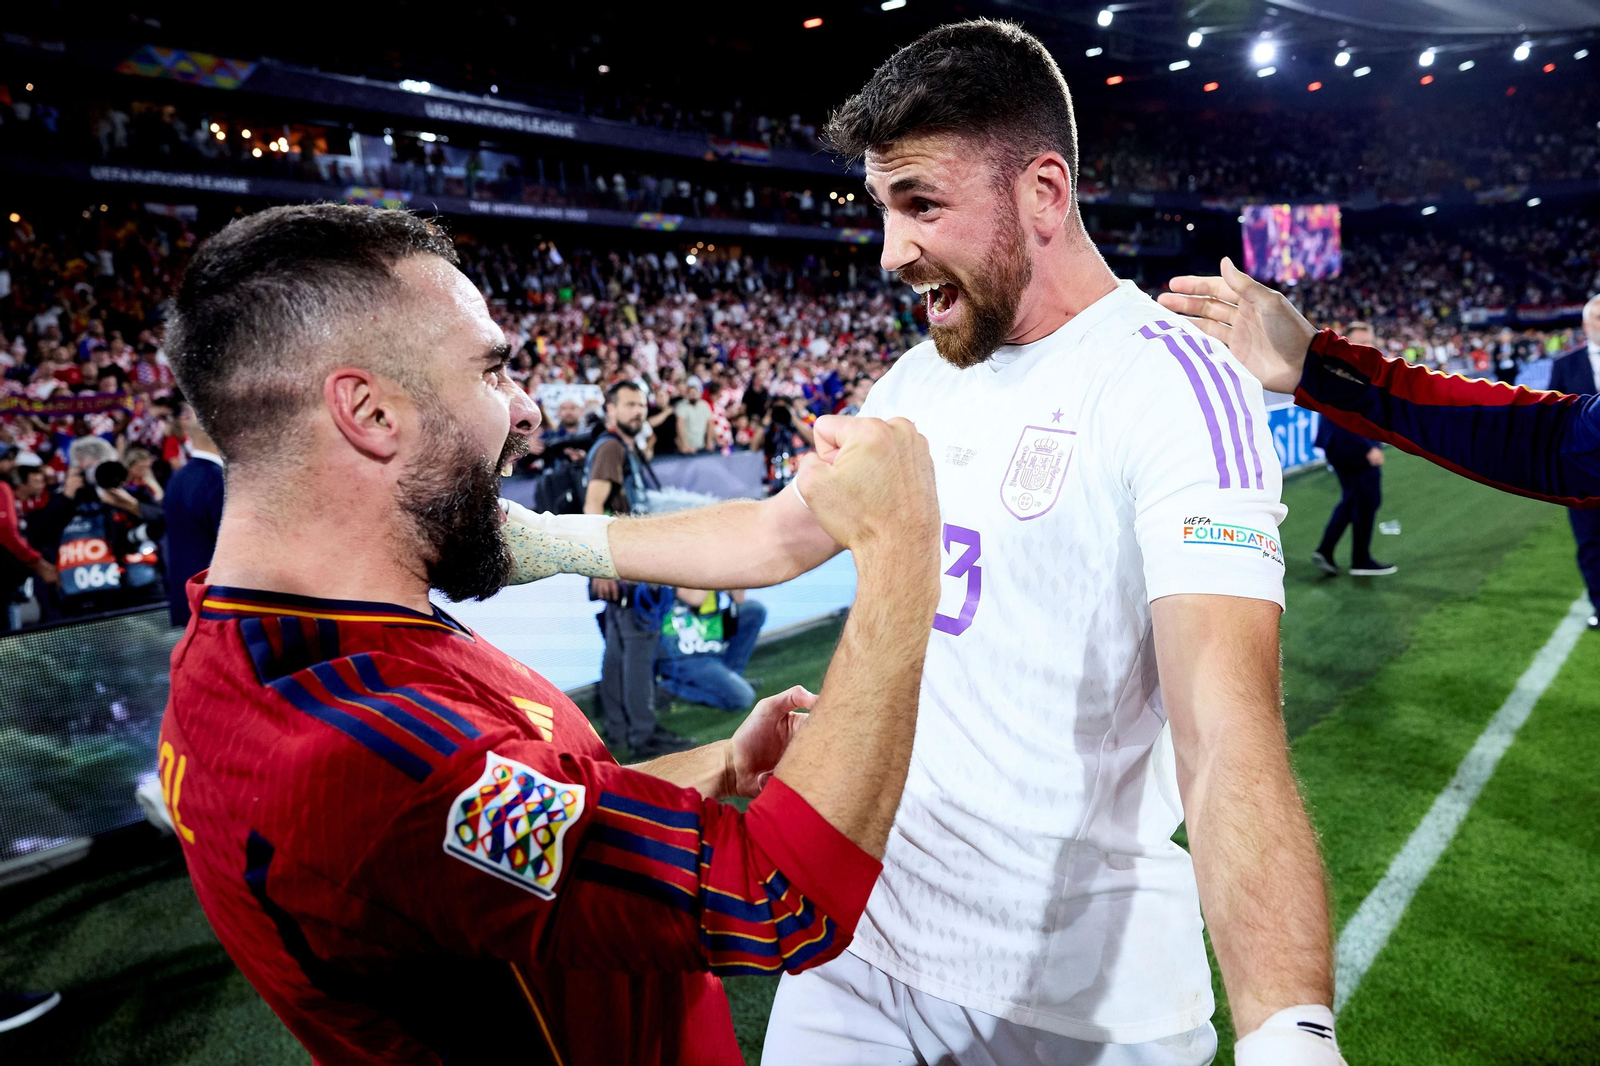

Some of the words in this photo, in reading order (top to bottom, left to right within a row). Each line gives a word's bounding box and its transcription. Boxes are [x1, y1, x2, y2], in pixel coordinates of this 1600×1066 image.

[424, 101, 462, 121] UEFA
[463, 108, 523, 130] NATIONS
[524, 117, 575, 138] LEAGUE
[90, 165, 129, 182] UEFA
[130, 169, 194, 188] NATIONS
[195, 175, 250, 193] LEAGUE
[1183, 516, 1212, 526] UEFA
[932, 523, 982, 636] 3
